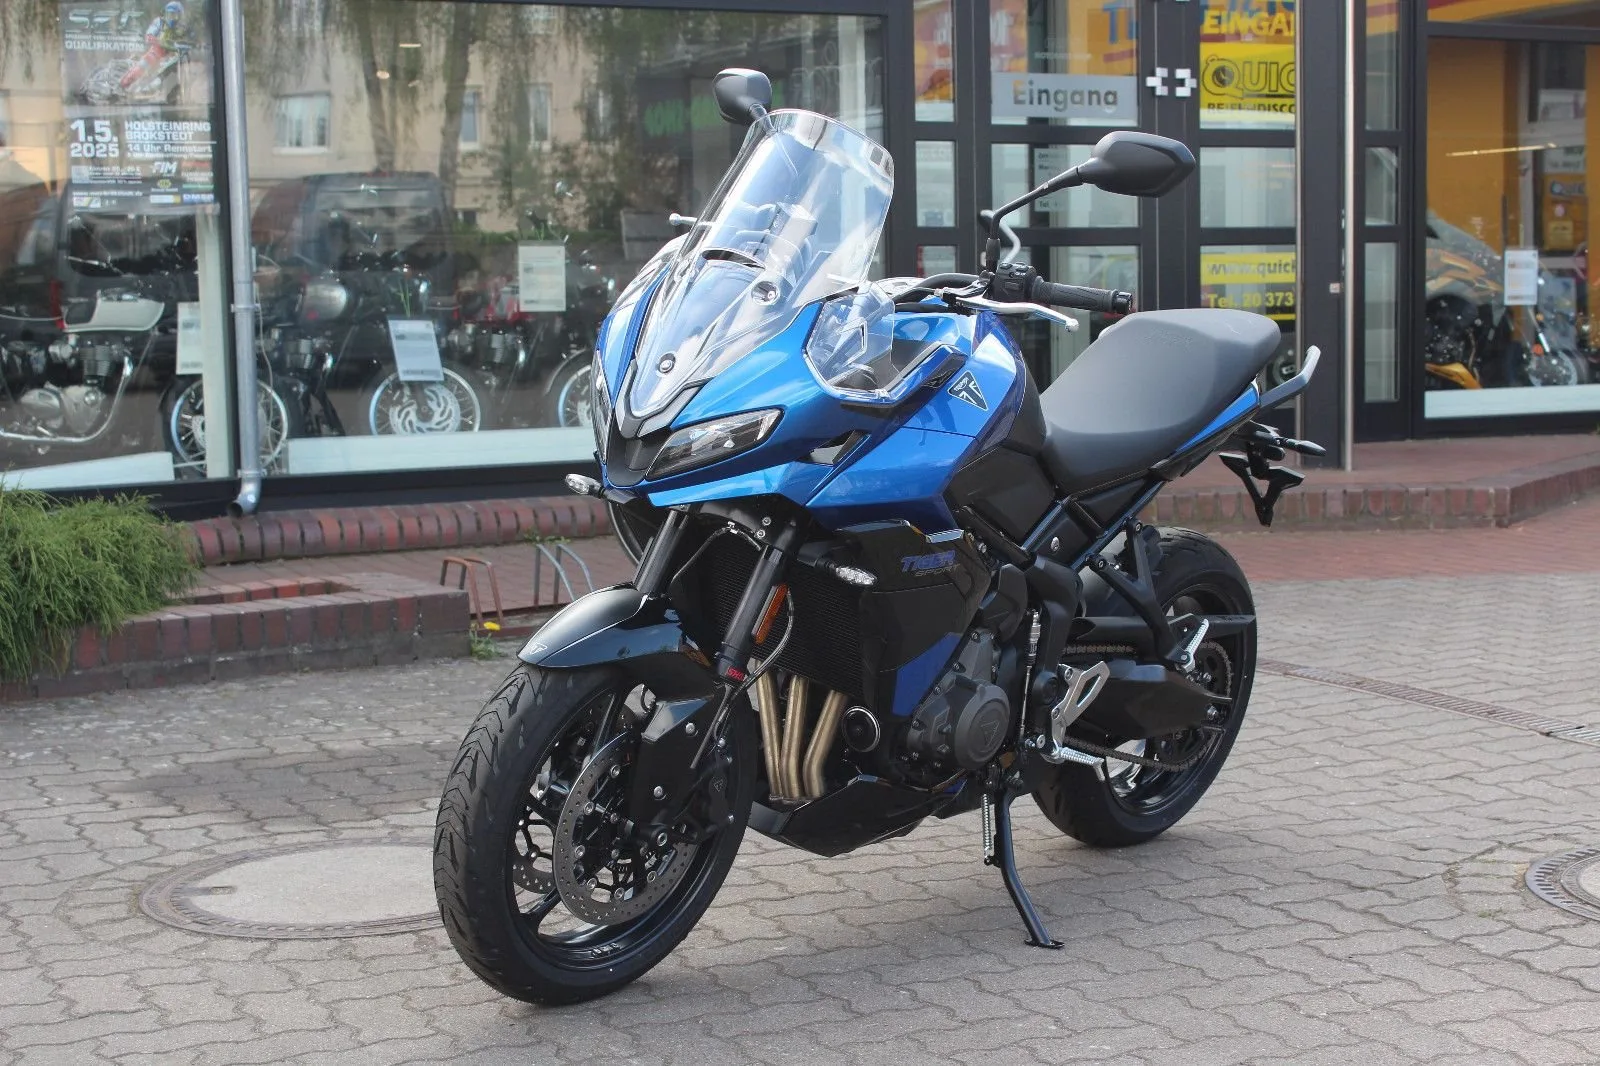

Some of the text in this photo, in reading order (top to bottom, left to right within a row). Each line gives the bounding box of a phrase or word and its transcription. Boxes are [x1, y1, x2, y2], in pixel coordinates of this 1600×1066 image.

[65, 40, 145, 52] QUALIFIKATION
[71, 120, 118, 142] 1.5.
[125, 121, 211, 132] HOLSTEINRING
[125, 131, 193, 141] BROKSTEDT
[70, 142, 119, 158] 2025
[127, 144, 140, 152] 14
[143, 144, 162, 152] Uhr
[1265, 291, 1294, 307] 373
[901, 549, 956, 573] TIGER
[915, 563, 961, 577] SPORT
